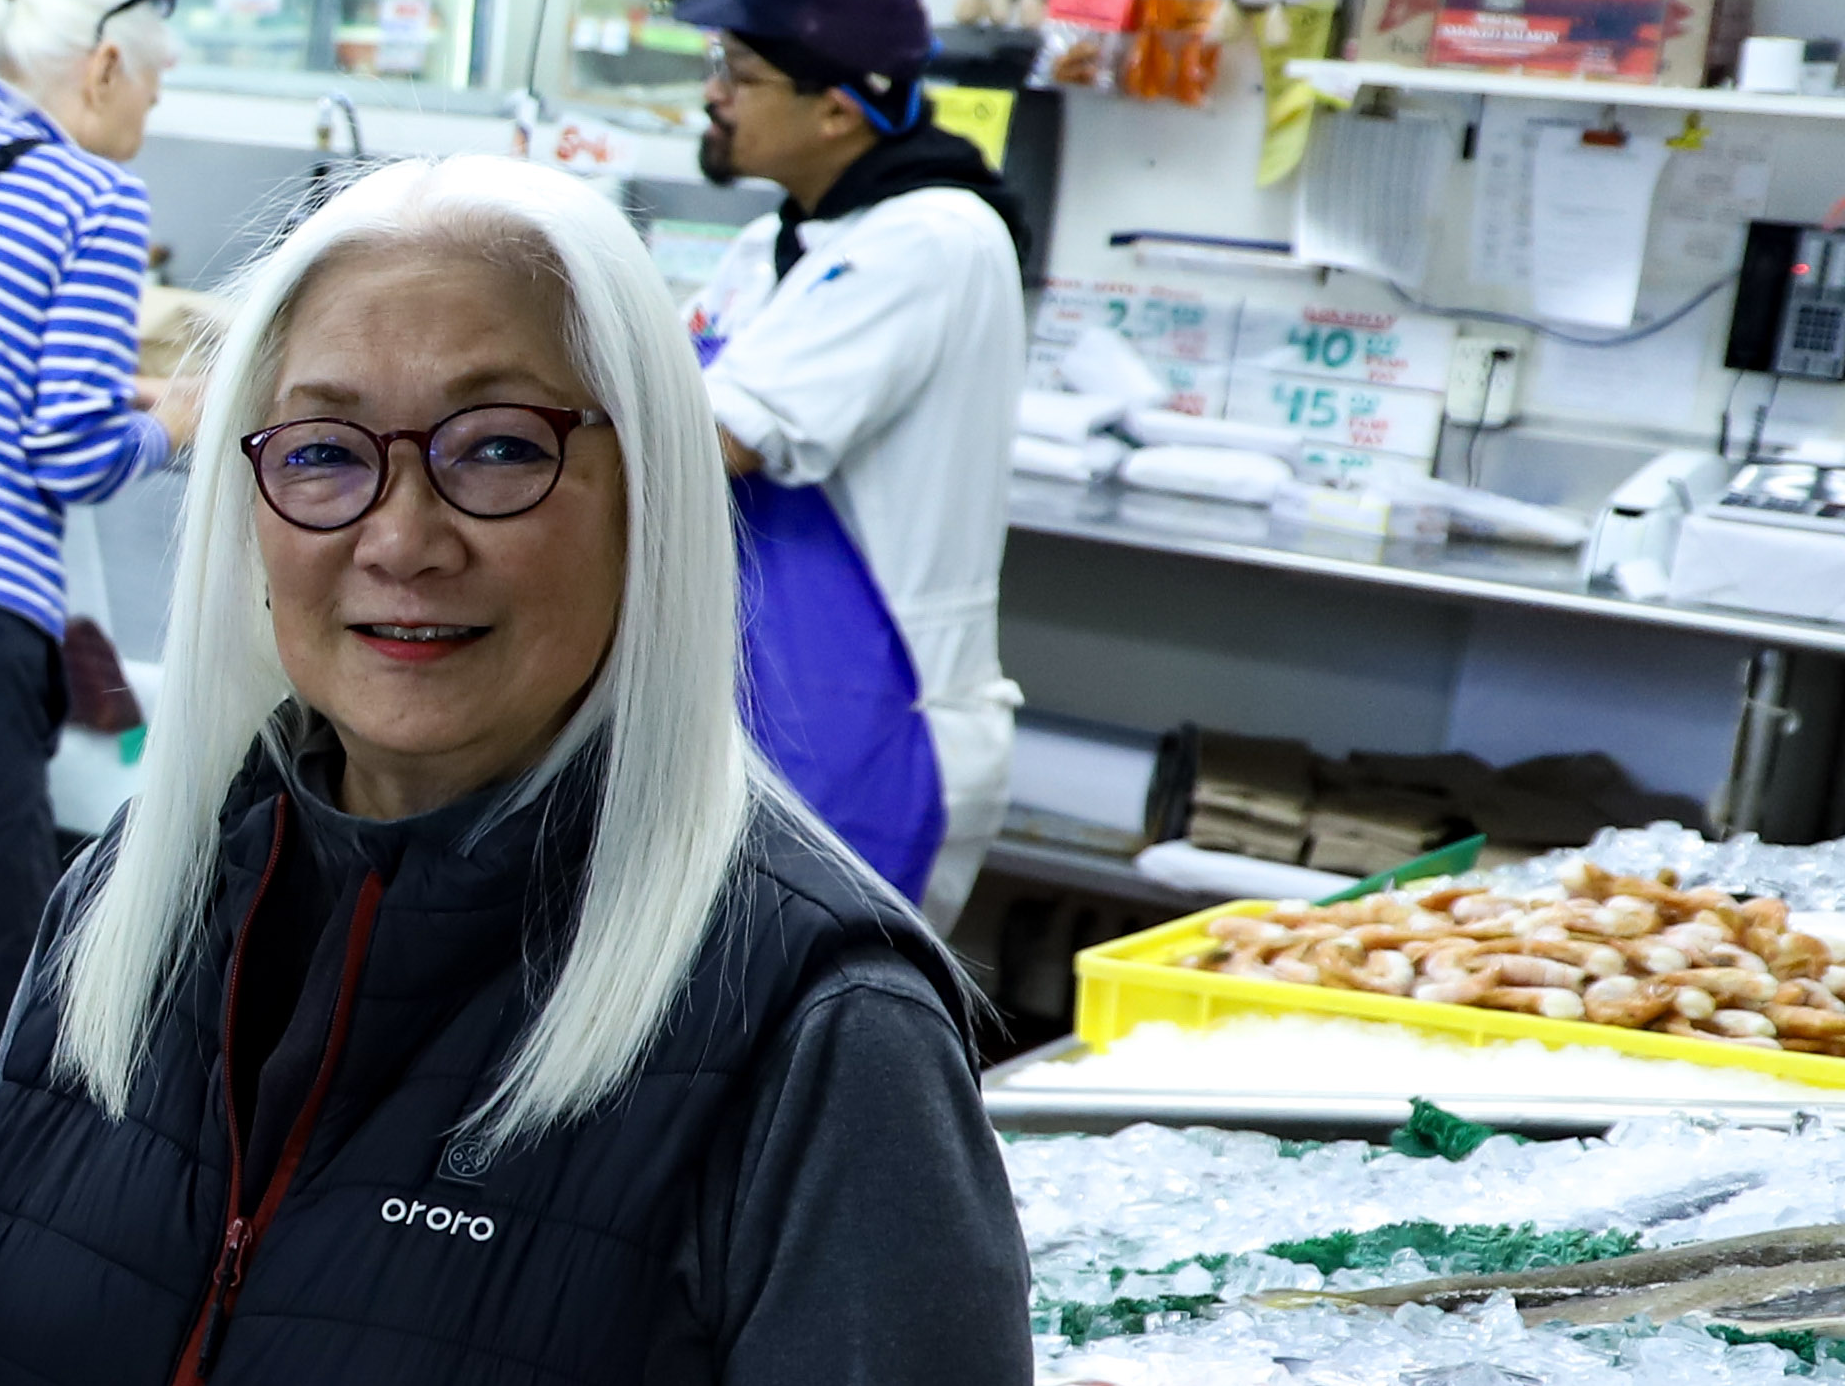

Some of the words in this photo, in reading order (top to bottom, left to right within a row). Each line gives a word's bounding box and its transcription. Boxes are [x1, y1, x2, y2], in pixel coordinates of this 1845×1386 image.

[1287, 324, 1356, 369] 40
[1271, 382, 1338, 429] 45
[380, 1196, 496, 1242] ororo
